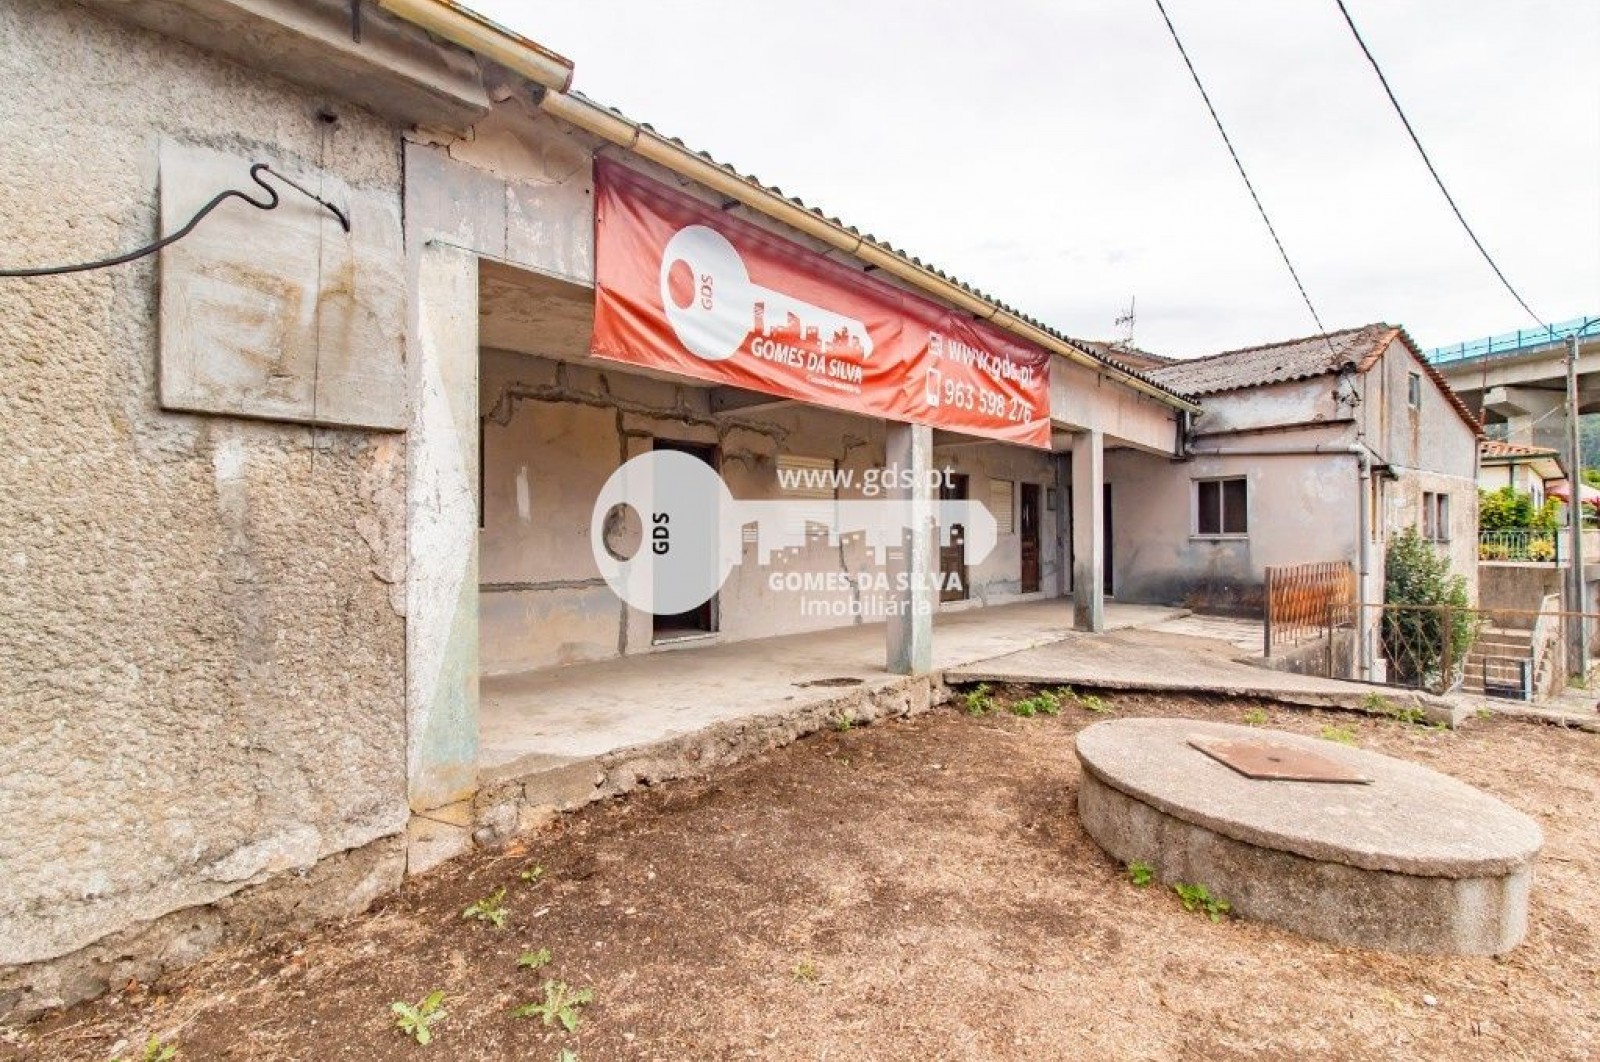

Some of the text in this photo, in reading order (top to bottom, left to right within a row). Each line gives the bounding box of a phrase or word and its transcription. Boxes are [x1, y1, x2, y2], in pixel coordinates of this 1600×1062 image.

[701, 274, 714, 310] GDS
[750, 337, 863, 384] GOMES DA SILVA
[944, 378, 1032, 426] 963 598 276
